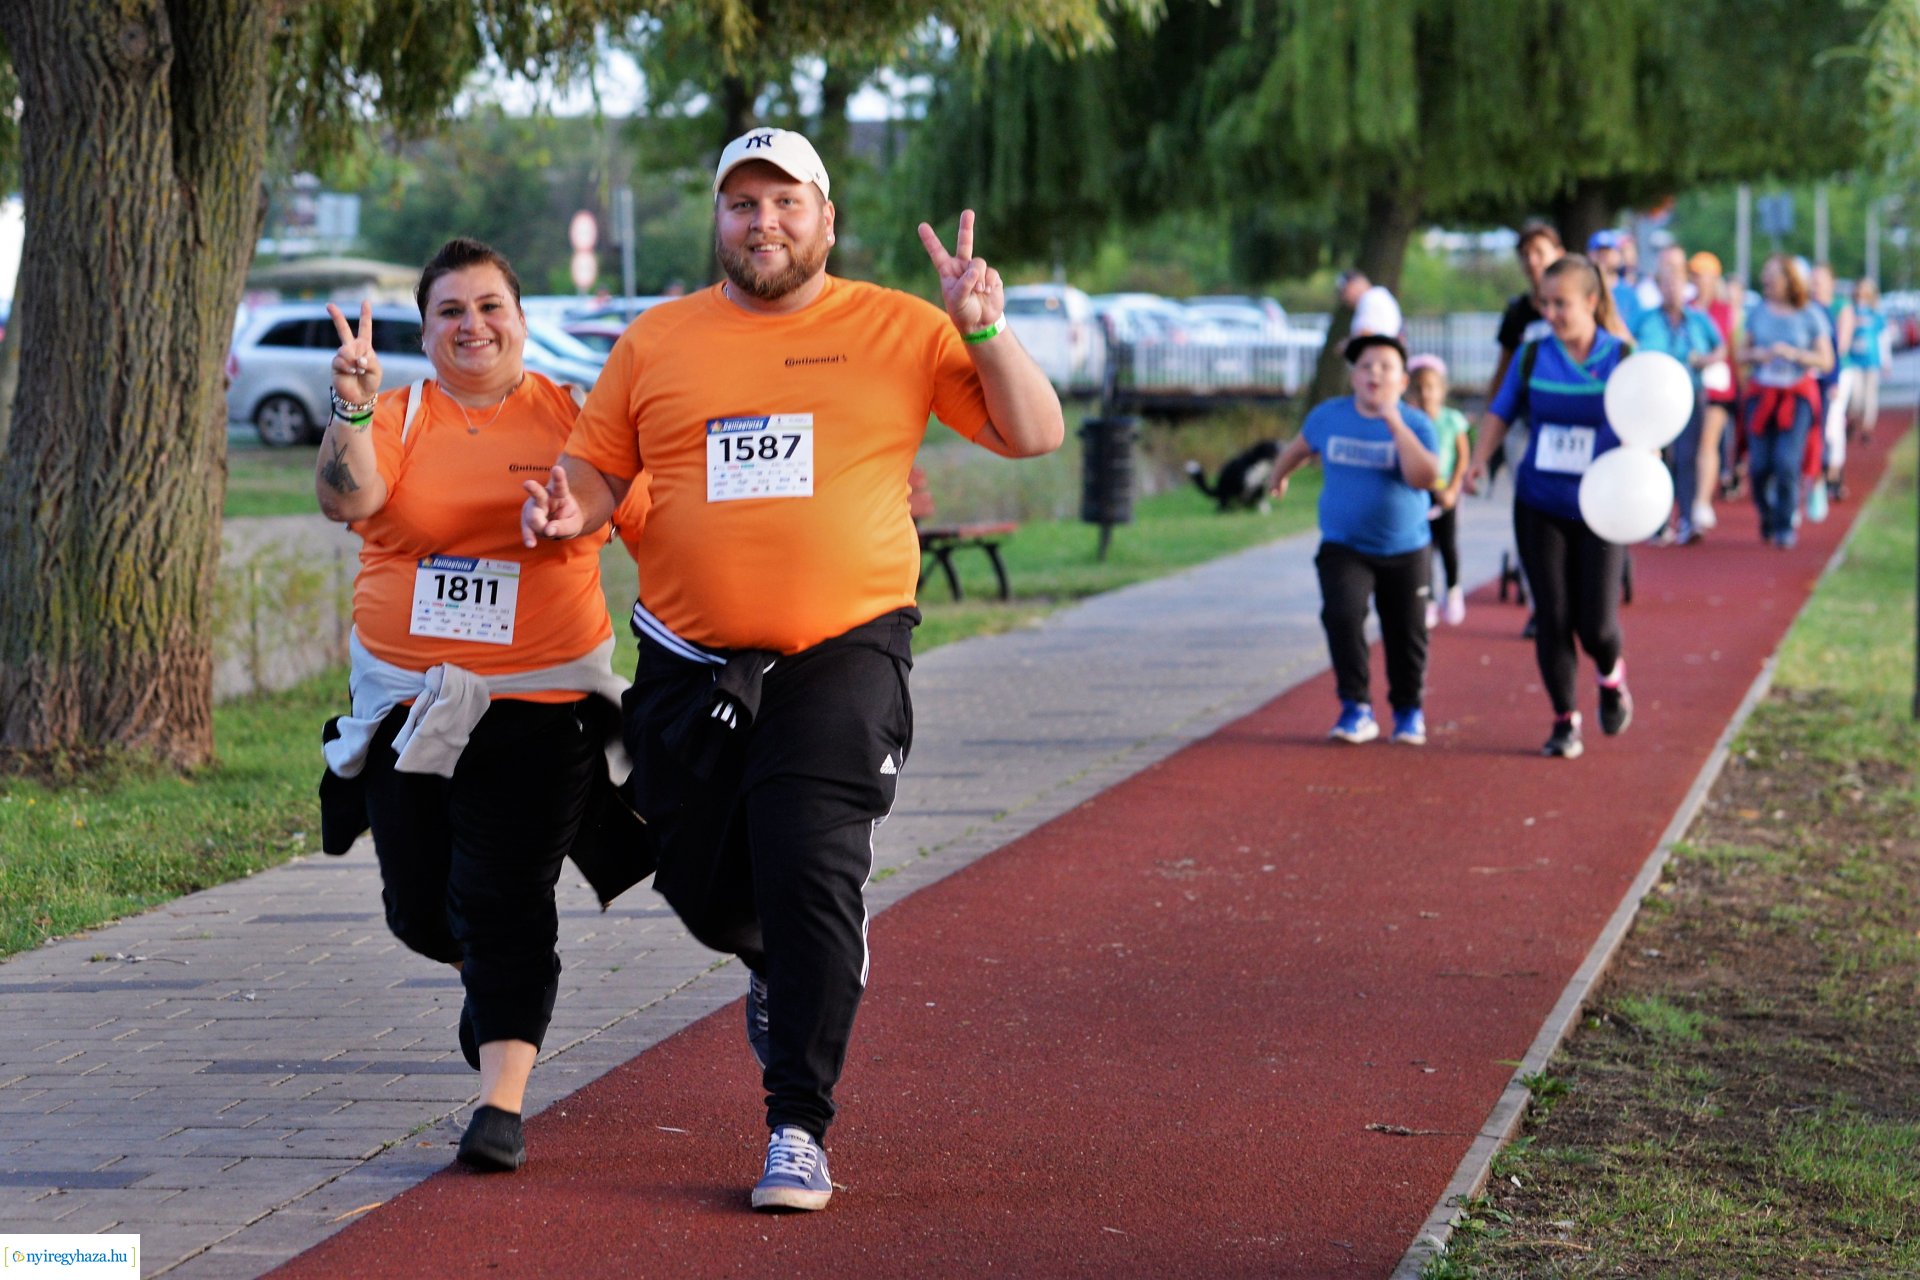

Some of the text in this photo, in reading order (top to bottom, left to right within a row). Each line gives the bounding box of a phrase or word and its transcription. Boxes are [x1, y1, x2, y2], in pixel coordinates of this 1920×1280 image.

[784, 354, 839, 368] Continental
[719, 435, 802, 463] 1587
[508, 463, 552, 473] Continen
[434, 574, 499, 607] 1811
